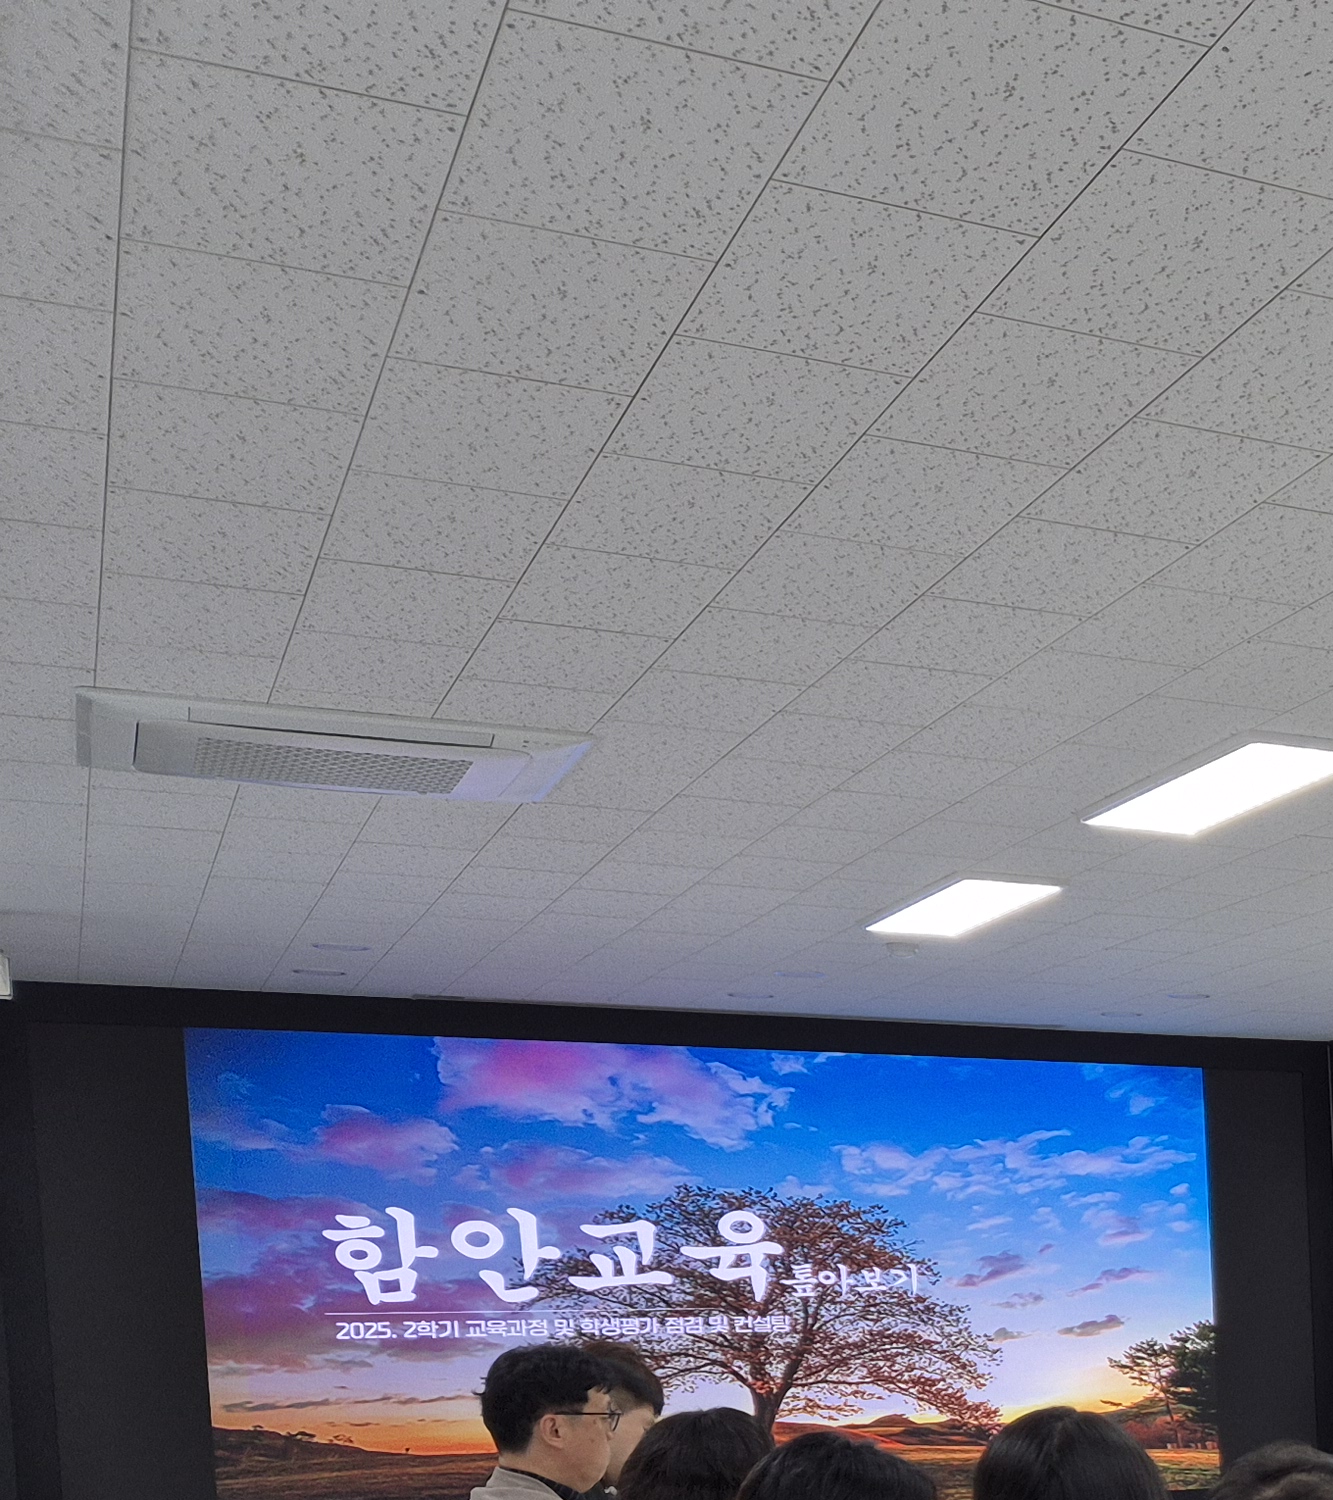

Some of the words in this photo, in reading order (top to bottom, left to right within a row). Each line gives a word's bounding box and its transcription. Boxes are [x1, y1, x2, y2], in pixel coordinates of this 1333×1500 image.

[322, 1207, 784, 1305] 함안교육
[780, 1263, 918, 1297] 톺아보기
[335, 1321, 398, 1340] 2025.
[403, 1320, 460, 1339] 2학기
[465, 1319, 548, 1338] 교육과정
[554, 1318, 575, 1337] 및
[580, 1317, 659, 1336] 학생평가
[665, 1316, 704, 1335] 점검
[708, 1315, 729, 1334] 및
[734, 1315, 791, 1334] 컨설팅
